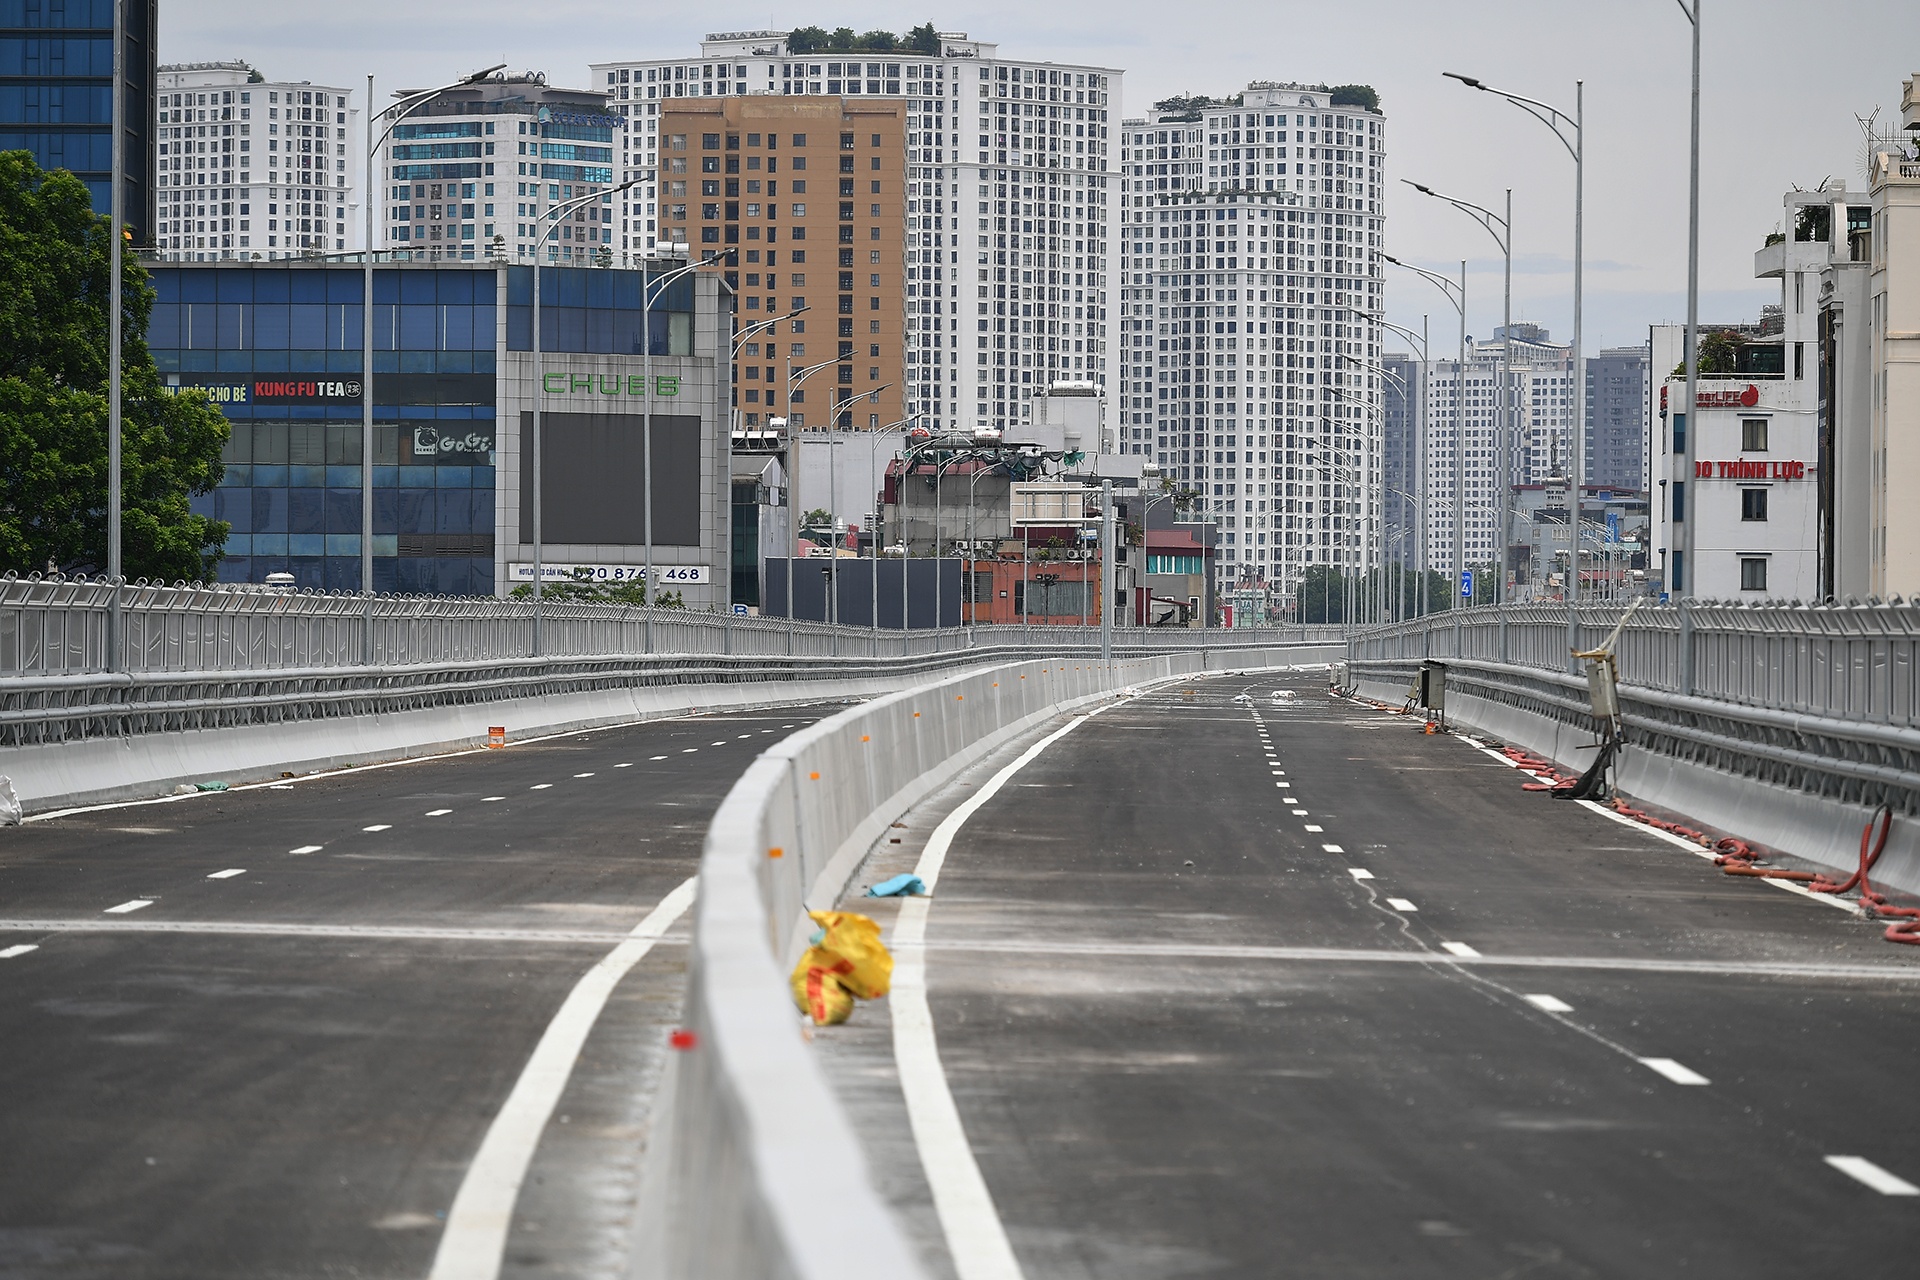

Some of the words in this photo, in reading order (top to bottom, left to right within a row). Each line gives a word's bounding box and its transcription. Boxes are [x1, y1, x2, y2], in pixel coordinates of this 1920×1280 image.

[553, 111, 591, 126] OCEAN
[590, 114, 625, 128] GROUP
[255, 381, 296, 397] KUNG
[297, 381, 316, 397] FU
[317, 381, 345, 397] TEA
[543, 372, 680, 396] CHUBB
[208, 386, 231, 402] CHO
[233, 384, 247, 402] BÉ
[1696, 390, 1740, 402] earLIFE
[1717, 457, 1767, 479] THÍNH
[1772, 459, 1805, 483] LỰC
[614, 567, 647, 579] 876
[665, 568, 700, 580] 468
[1461, 581, 1470, 594] 4
